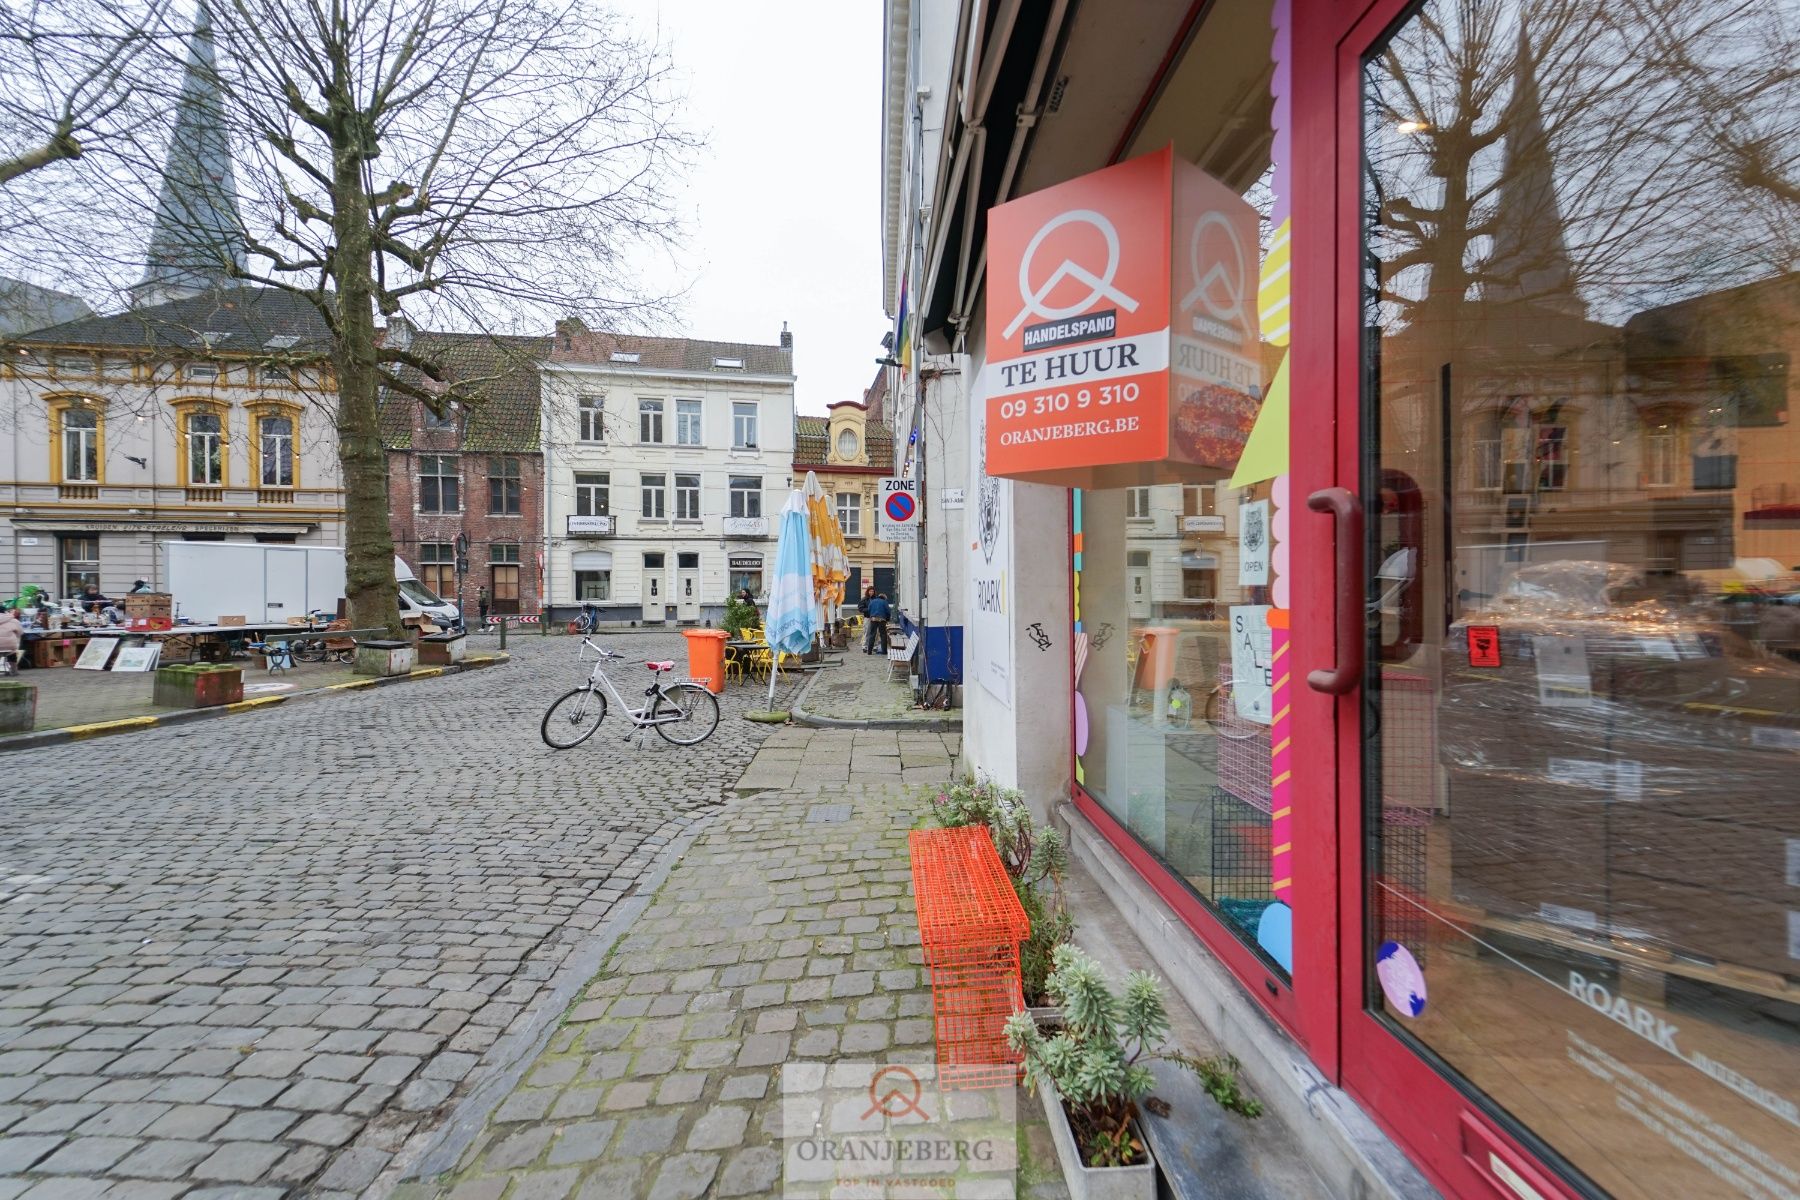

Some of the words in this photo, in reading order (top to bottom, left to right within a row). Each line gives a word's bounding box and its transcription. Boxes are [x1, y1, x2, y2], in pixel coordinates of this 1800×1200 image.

[1024, 316, 1115, 346] HANDELSPAND
[1001, 361, 1037, 388] TE
[1045, 343, 1139, 381] HUUR
[1000, 399, 1027, 420] 09
[1033, 393, 1069, 415] 310
[1077, 389, 1091, 409] 9
[1099, 382, 1140, 405] 310
[1000, 416, 1139, 446] ORANJEBERG.BE
[885, 480, 915, 491] ZONE
[1245, 561, 1264, 572] OPEN
[978, 579, 1001, 615] ROARK
[1236, 615, 1272, 687] SALE
[1569, 970, 1680, 1054] ROARK
